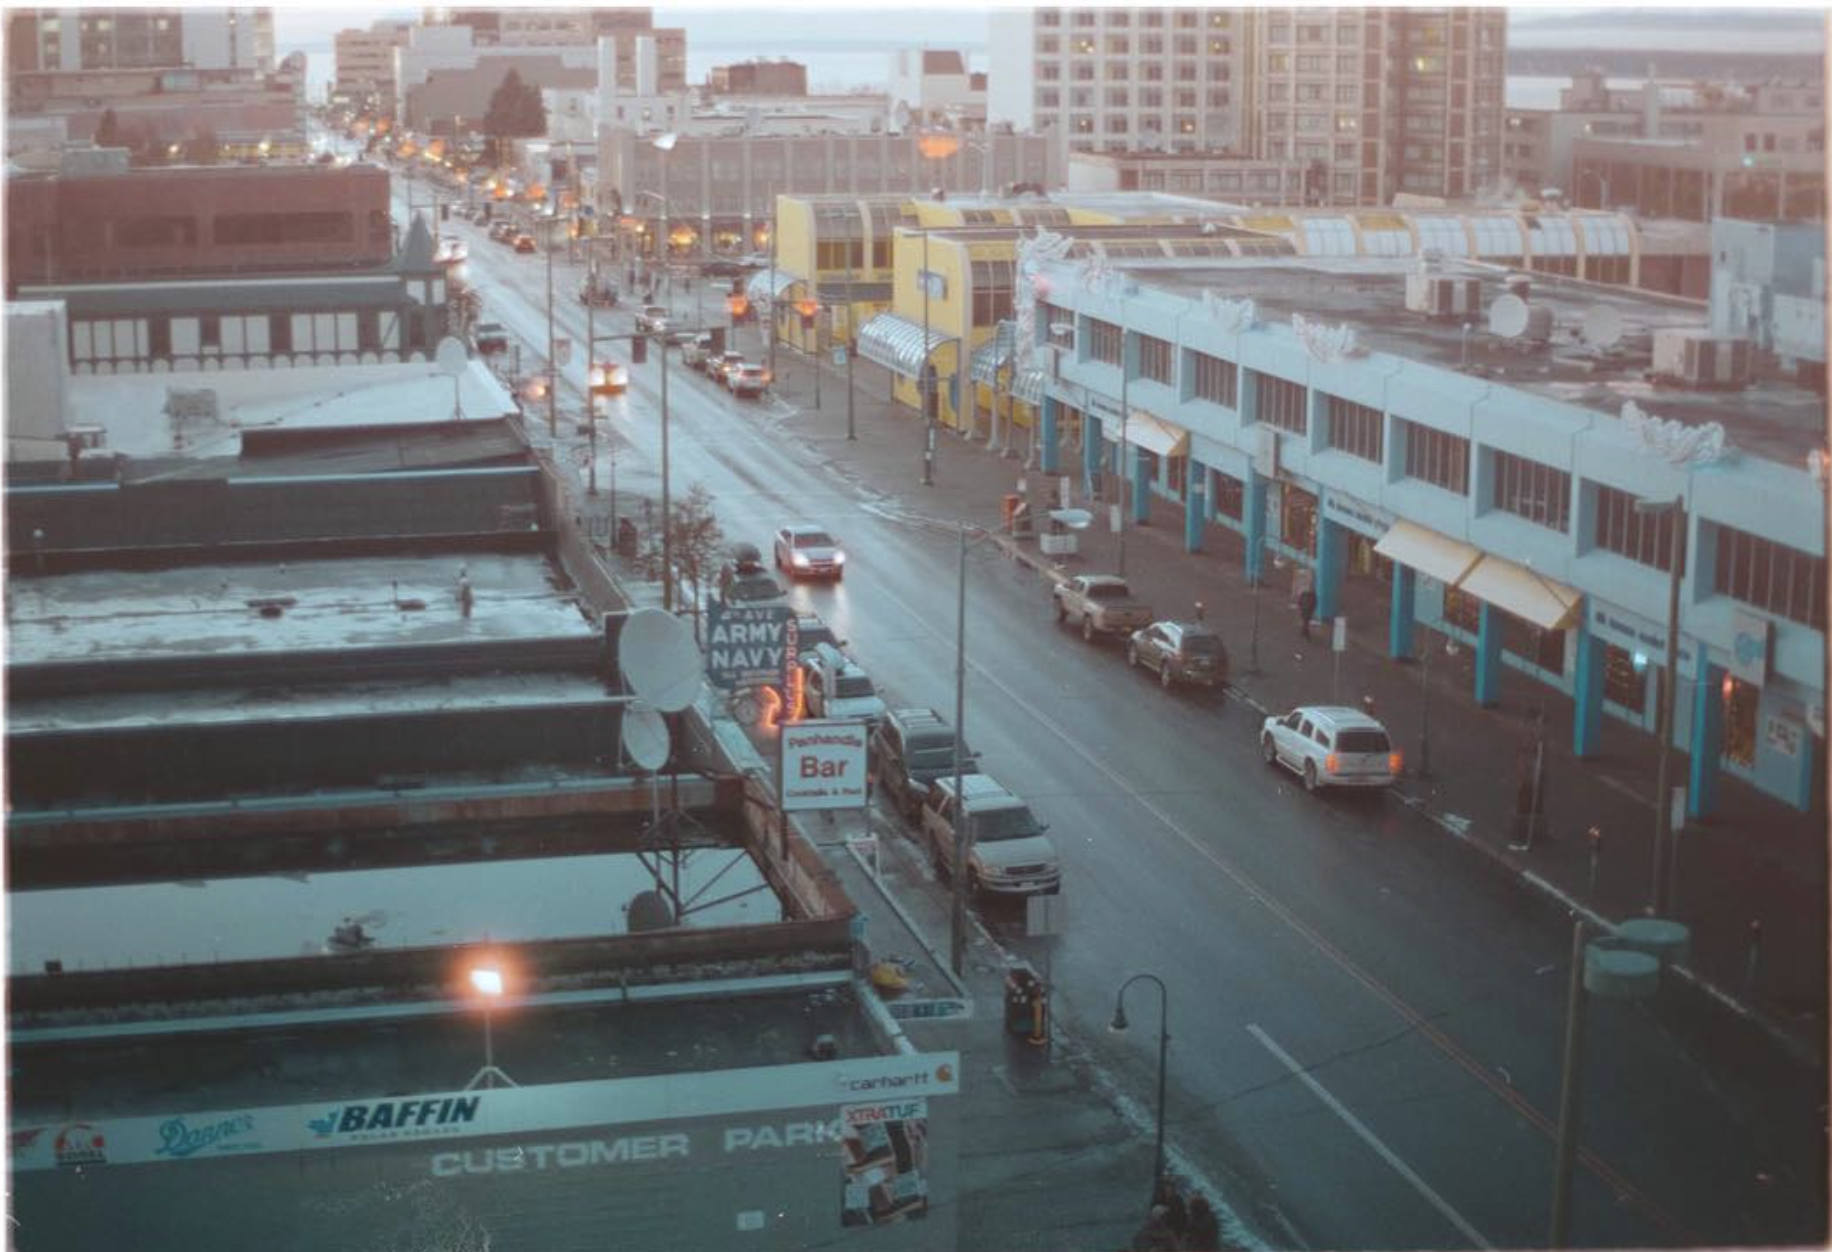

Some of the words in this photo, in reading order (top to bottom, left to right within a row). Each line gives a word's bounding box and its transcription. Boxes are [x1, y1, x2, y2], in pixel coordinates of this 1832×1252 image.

[712, 622, 783, 643] ARMY
[712, 647, 783, 669] NAVY
[800, 755, 848, 778] Bar
[850, 1073, 928, 1091] carhartt
[338, 1095, 481, 1133] BAFFIN
[845, 1103, 920, 1123] XTRATUF
[431, 1133, 689, 1177] CUSTOMER
